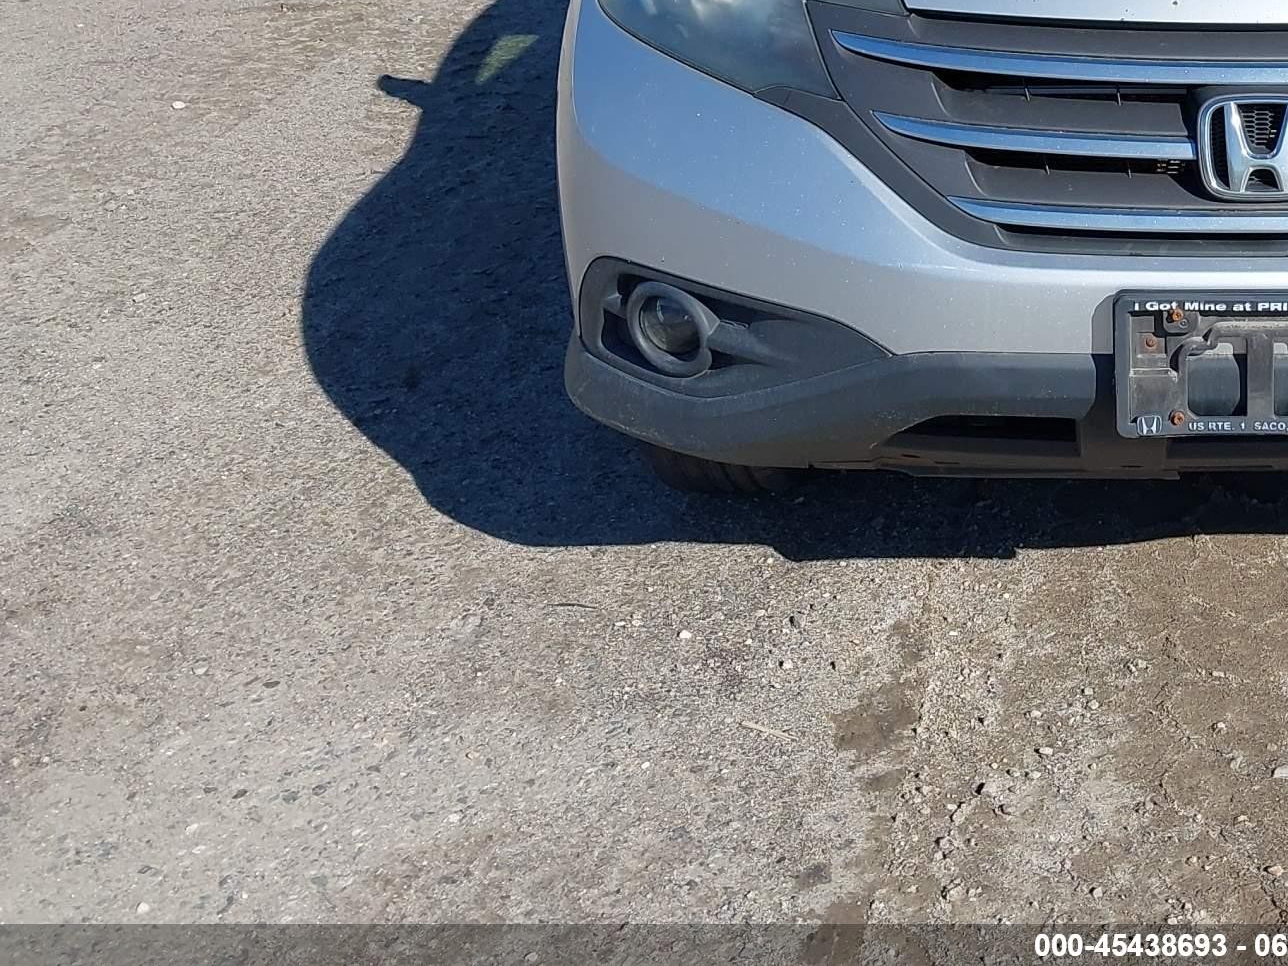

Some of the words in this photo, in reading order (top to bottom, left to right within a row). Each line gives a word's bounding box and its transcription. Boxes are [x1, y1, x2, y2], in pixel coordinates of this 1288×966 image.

[1145, 301, 1179, 311] Got
[1184, 301, 1227, 311] Mine
[1232, 302, 1252, 311] at
[1188, 421, 1205, 431] US
[1208, 421, 1235, 431] RTE.
[1240, 421, 1246, 430] 1
